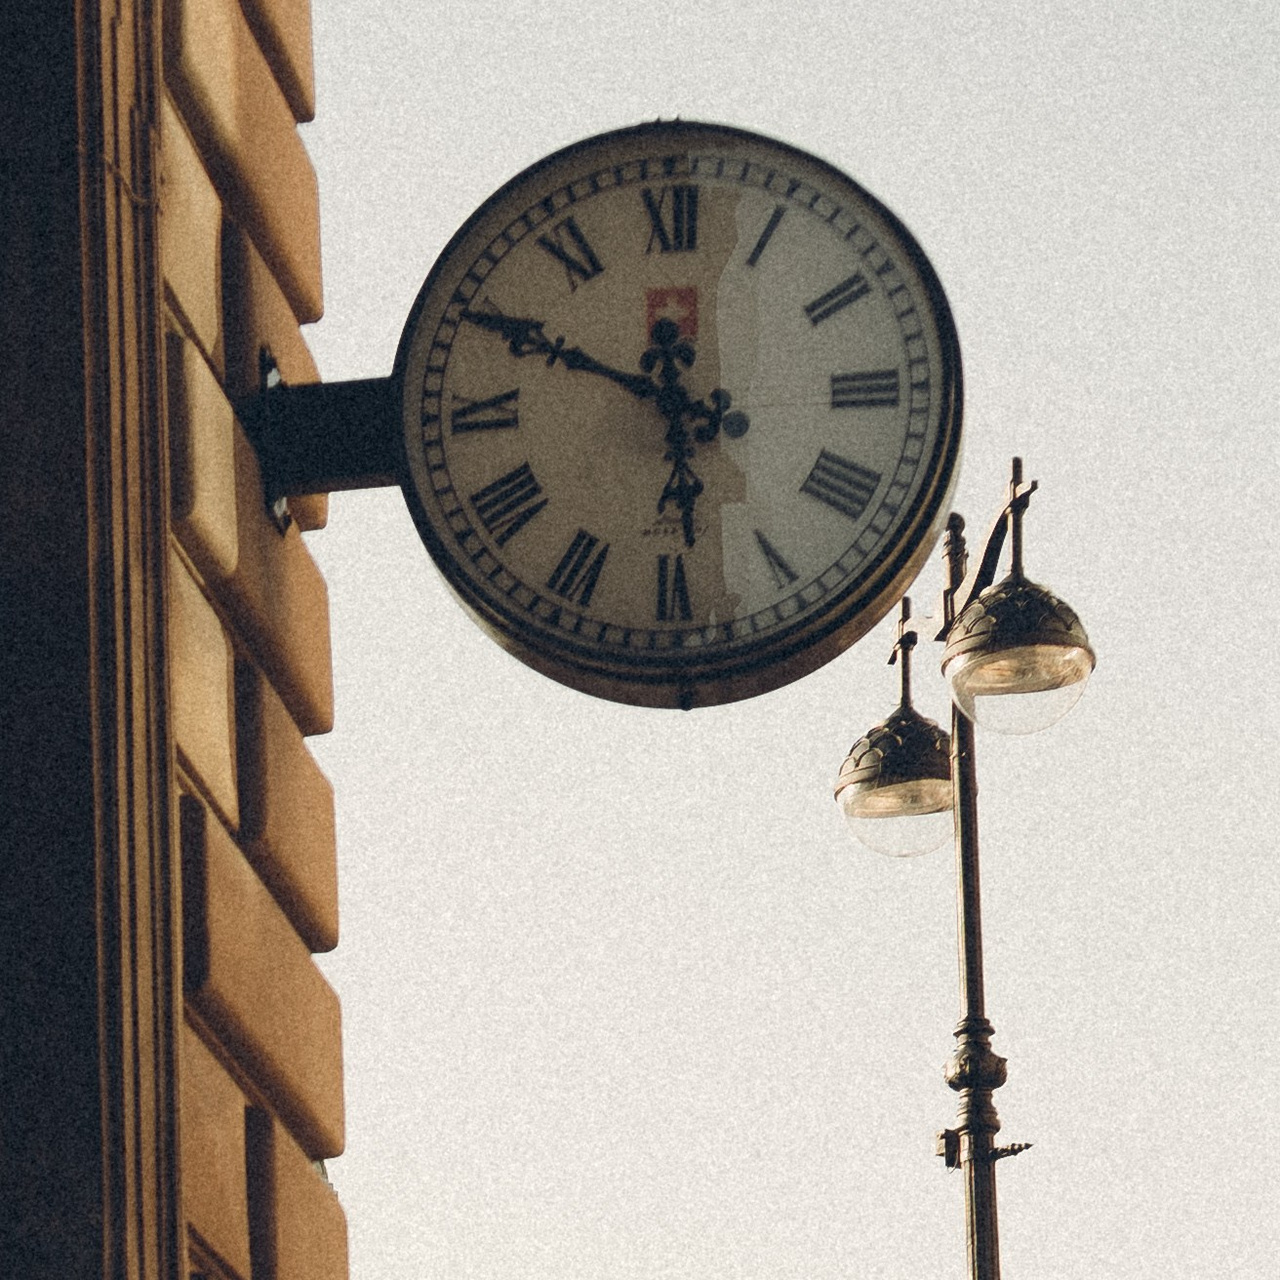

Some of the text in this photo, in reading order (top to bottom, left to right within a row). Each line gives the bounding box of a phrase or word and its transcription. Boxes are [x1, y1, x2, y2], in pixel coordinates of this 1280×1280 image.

[536, 215, 606, 293] XI
[640, 184, 699, 254] XII
[803, 270, 872, 328] II
[451, 388, 520, 435] IX
[830, 369, 900, 410] III
[470, 460, 549, 549] VIII
[545, 528, 611, 608] VII
[656, 552, 694, 622] VI
